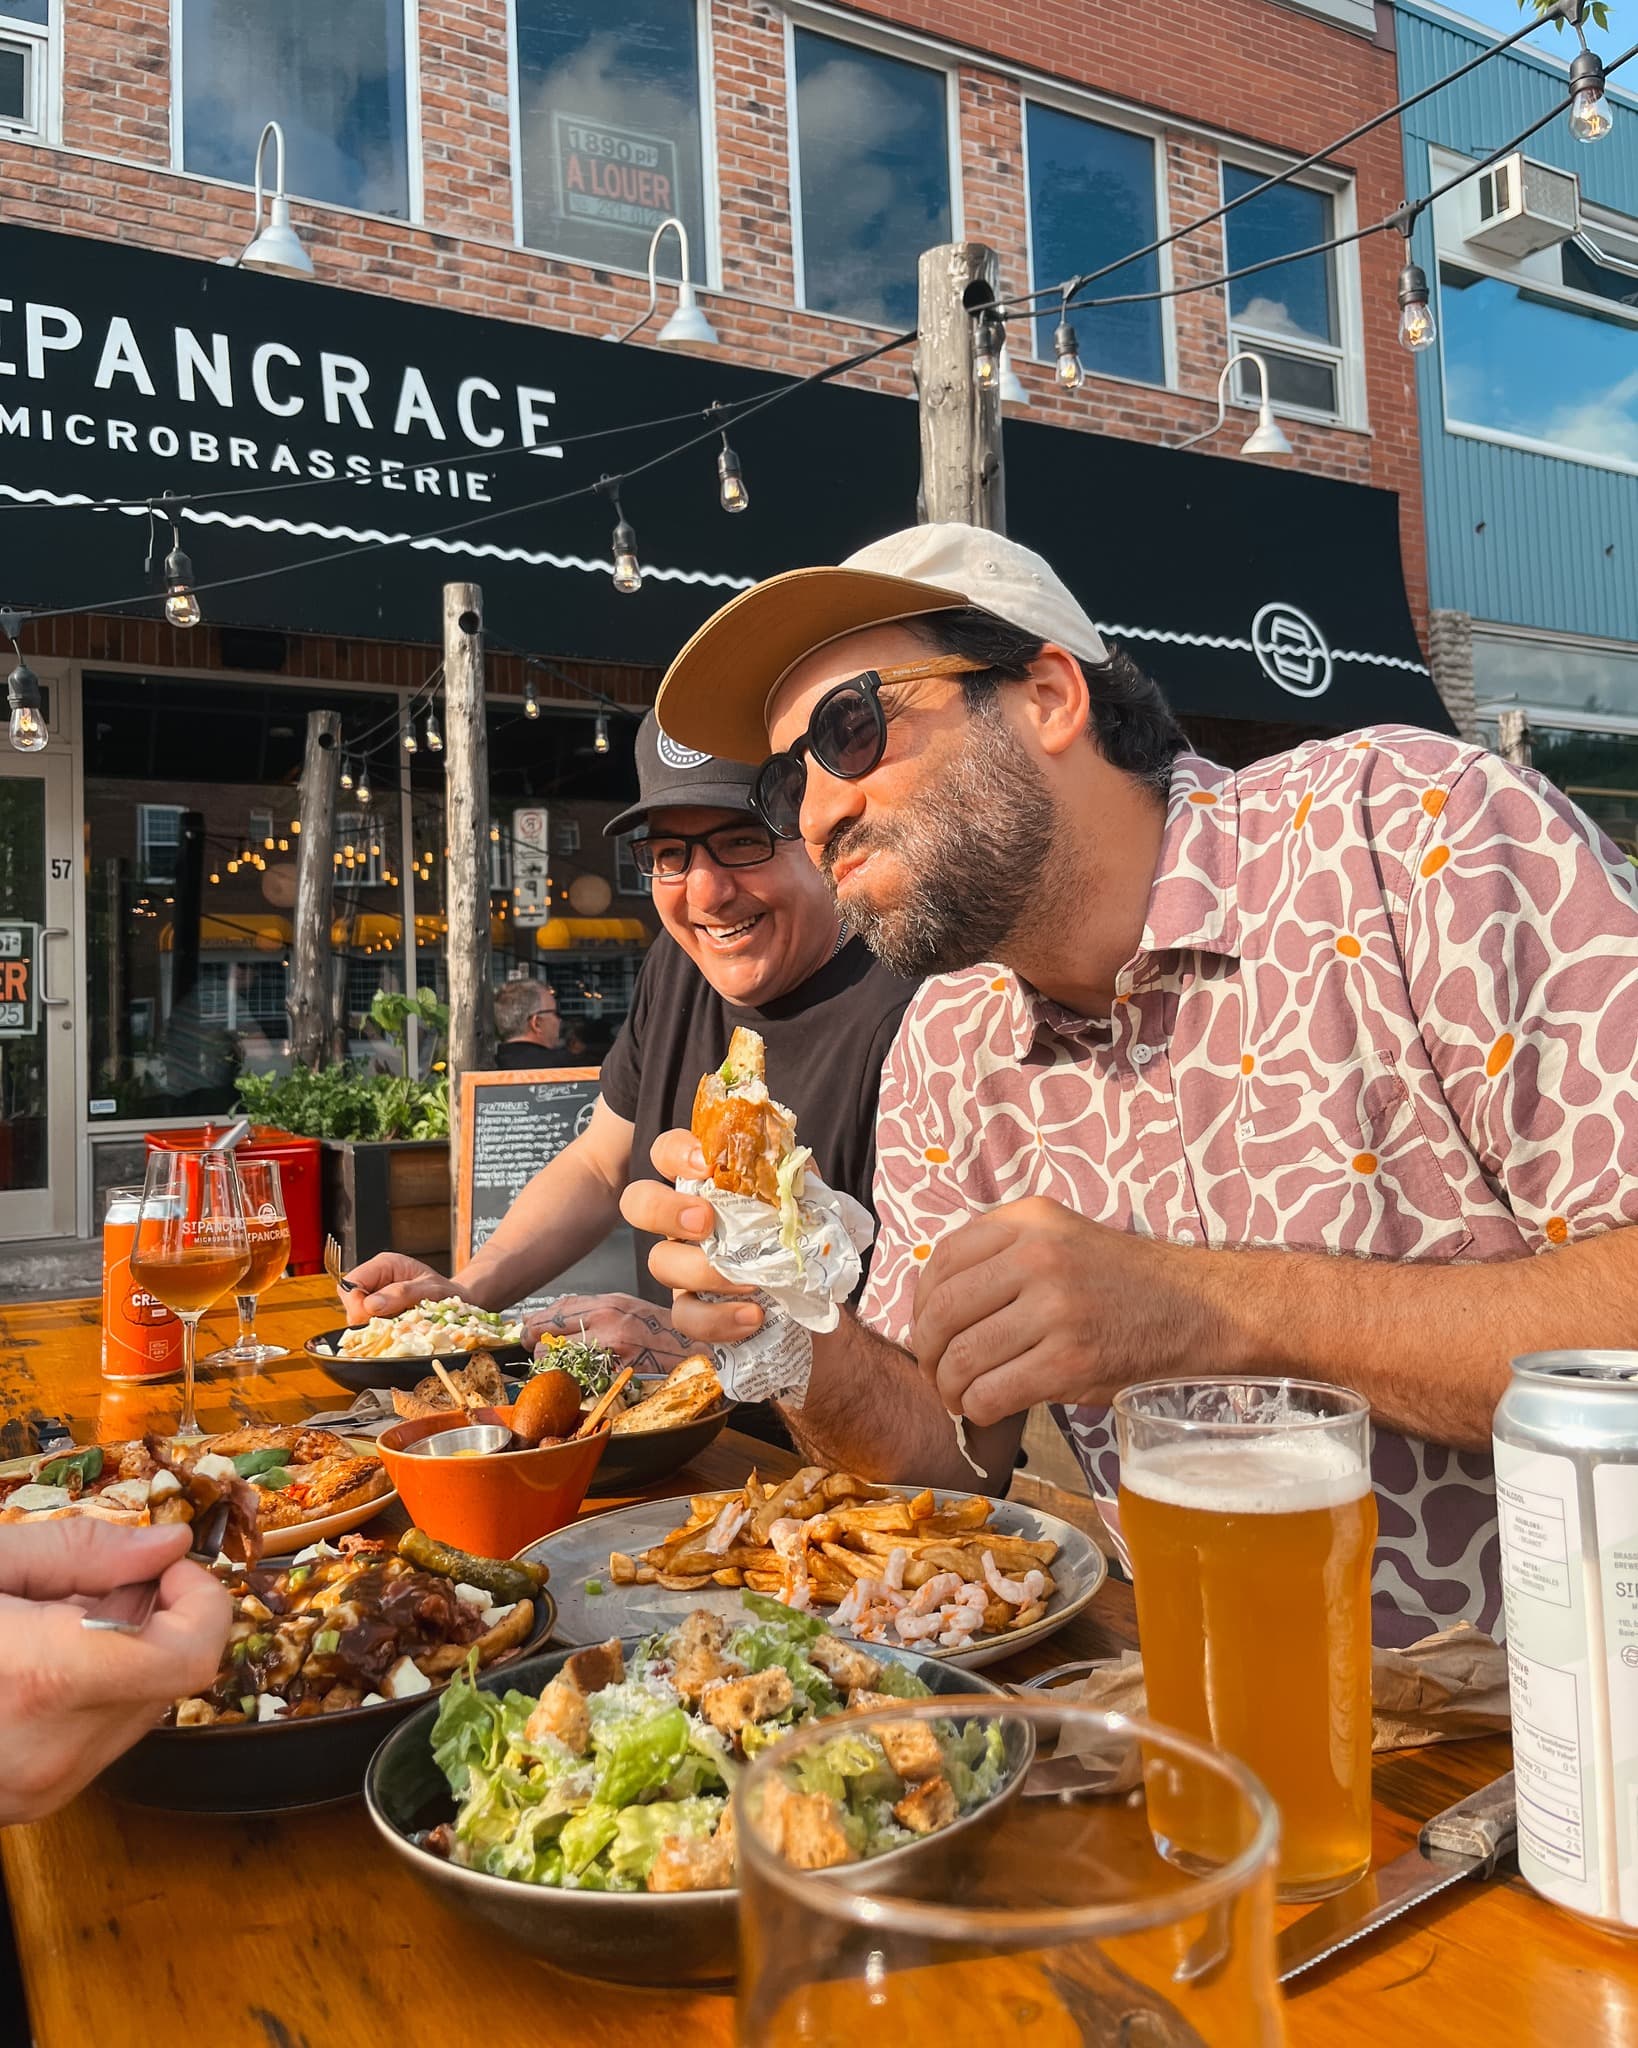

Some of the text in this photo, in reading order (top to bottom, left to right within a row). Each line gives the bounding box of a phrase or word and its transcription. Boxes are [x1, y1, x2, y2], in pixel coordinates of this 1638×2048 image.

[570, 129, 632, 162] 1890
[568, 154, 672, 210] A LOUER
[0, 404, 493, 503] MICROBRASSERIE
[51, 859, 71, 879] 57
